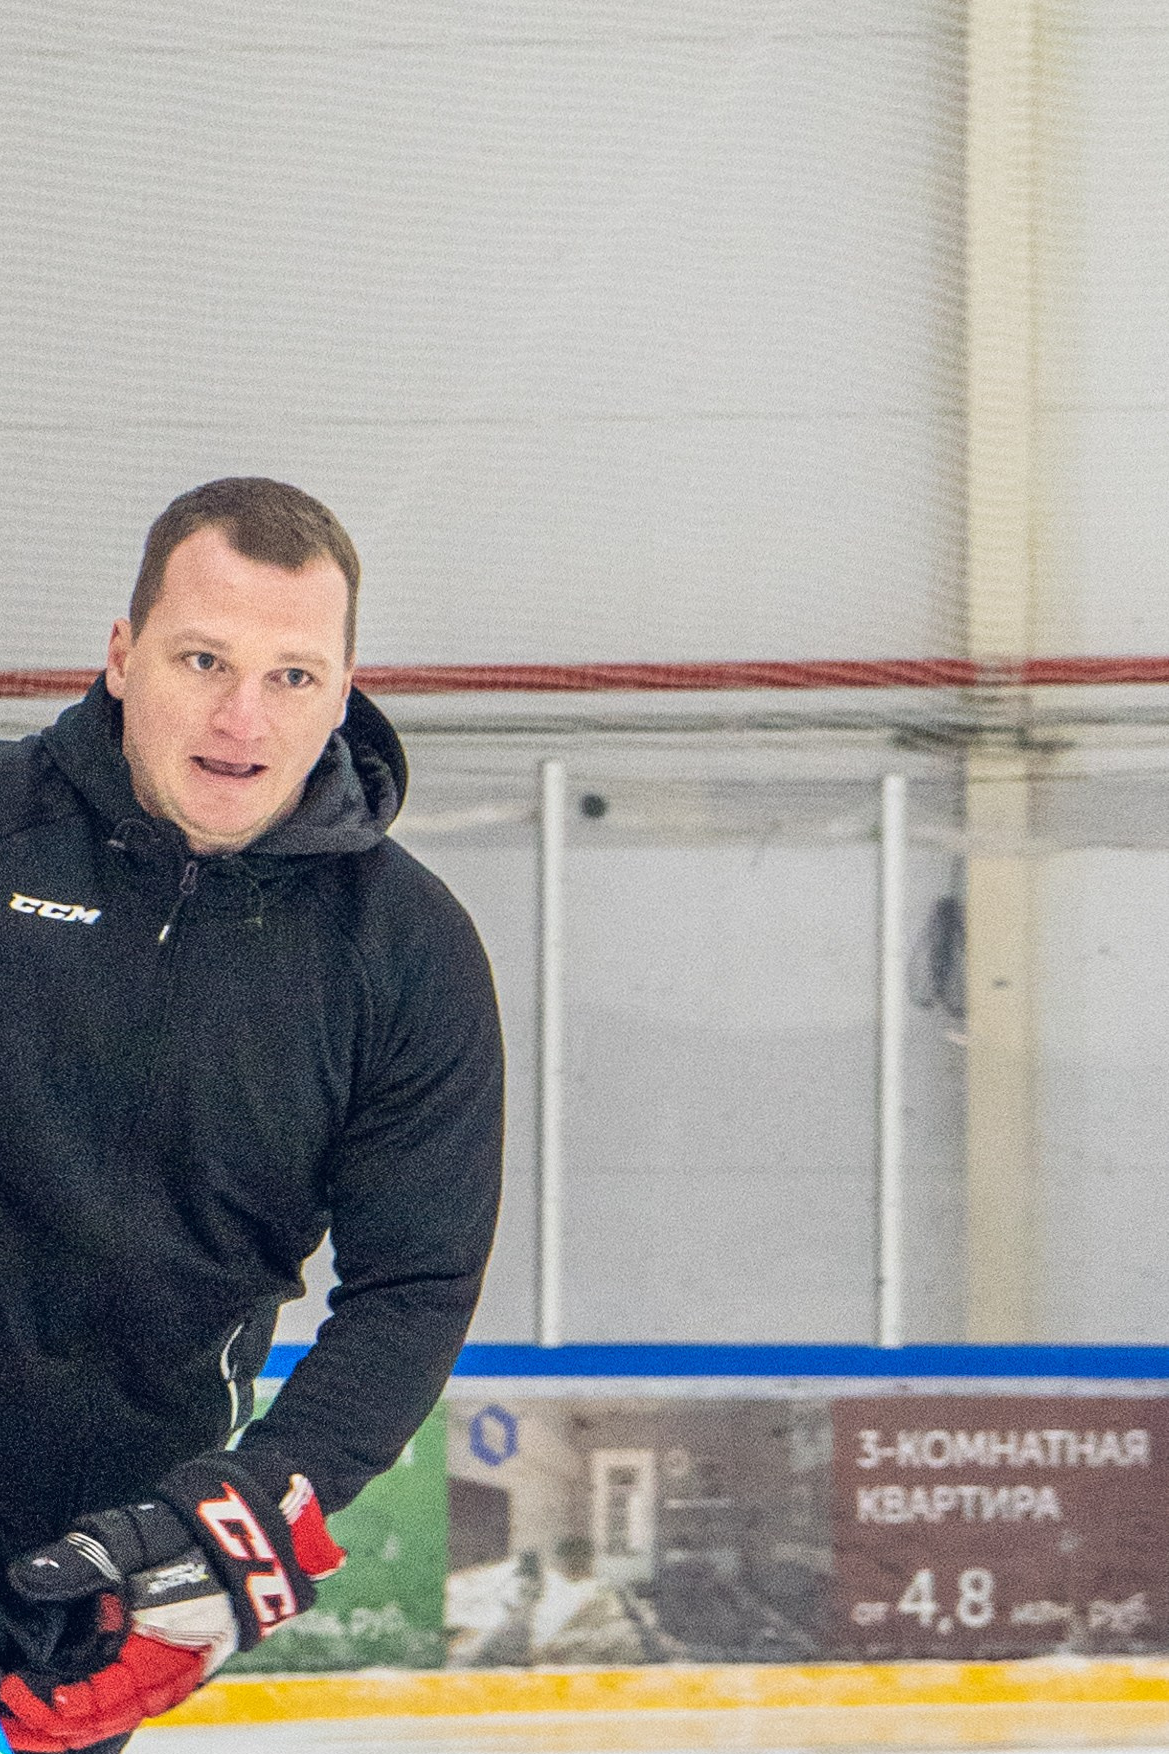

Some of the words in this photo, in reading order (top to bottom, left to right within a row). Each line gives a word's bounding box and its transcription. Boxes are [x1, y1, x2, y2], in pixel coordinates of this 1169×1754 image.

[9, 891, 102, 925] CCM
[855, 1428, 1150, 1469] 3-КОМНАТНАЯ
[855, 1485, 1063, 1524] КВАРТИРА
[195, 1480, 300, 1640] CC
[897, 1568, 996, 1636] 4,8
